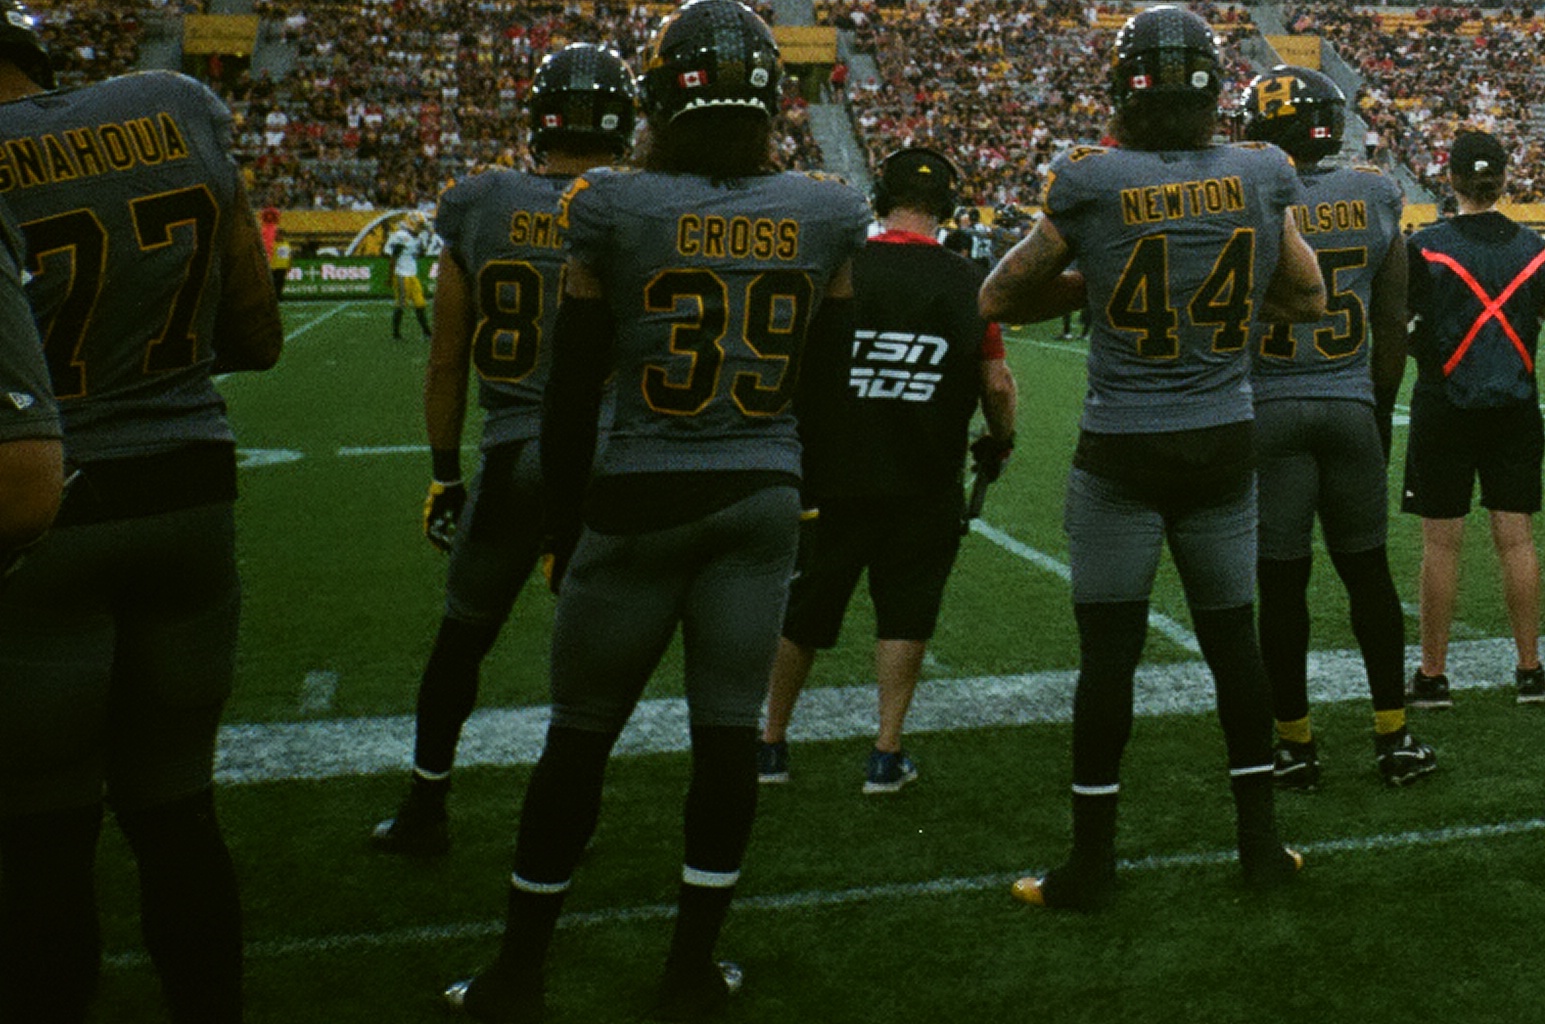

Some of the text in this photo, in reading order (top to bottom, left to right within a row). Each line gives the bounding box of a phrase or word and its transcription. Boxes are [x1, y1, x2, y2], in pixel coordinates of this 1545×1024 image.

[1120, 176, 1246, 225] NEWTON
[1291, 200, 1367, 235] ILSON
[677, 214, 800, 260] CROSS
[20, 183, 220, 400] 77
[1106, 227, 1256, 360] 44
[641, 267, 814, 417] 39
[852, 329, 950, 366] TSN
